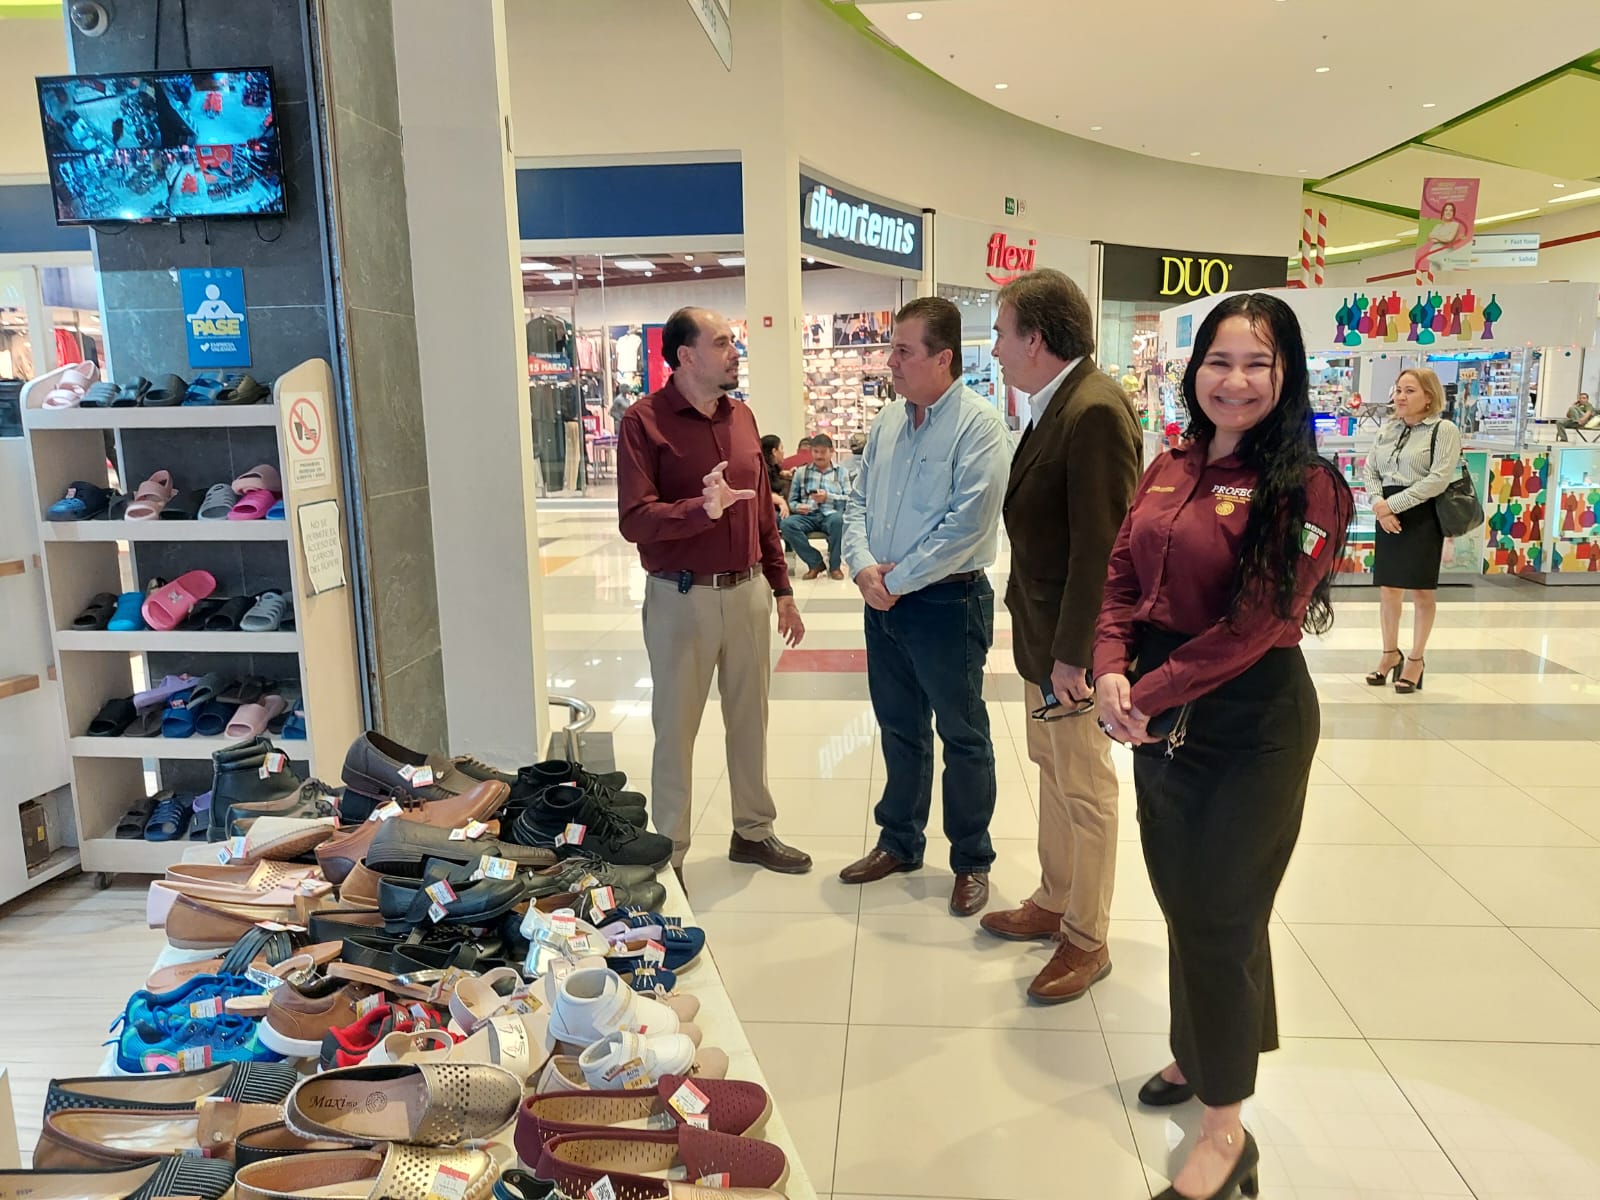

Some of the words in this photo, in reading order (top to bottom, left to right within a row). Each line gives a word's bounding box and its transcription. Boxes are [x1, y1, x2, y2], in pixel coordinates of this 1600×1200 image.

[987, 232, 1036, 271] flexi
[1160, 256, 1229, 296] DUO
[192, 319, 241, 337] PASE
[541, 362, 567, 372] MARZO
[1211, 485, 1254, 498] PROFEC
